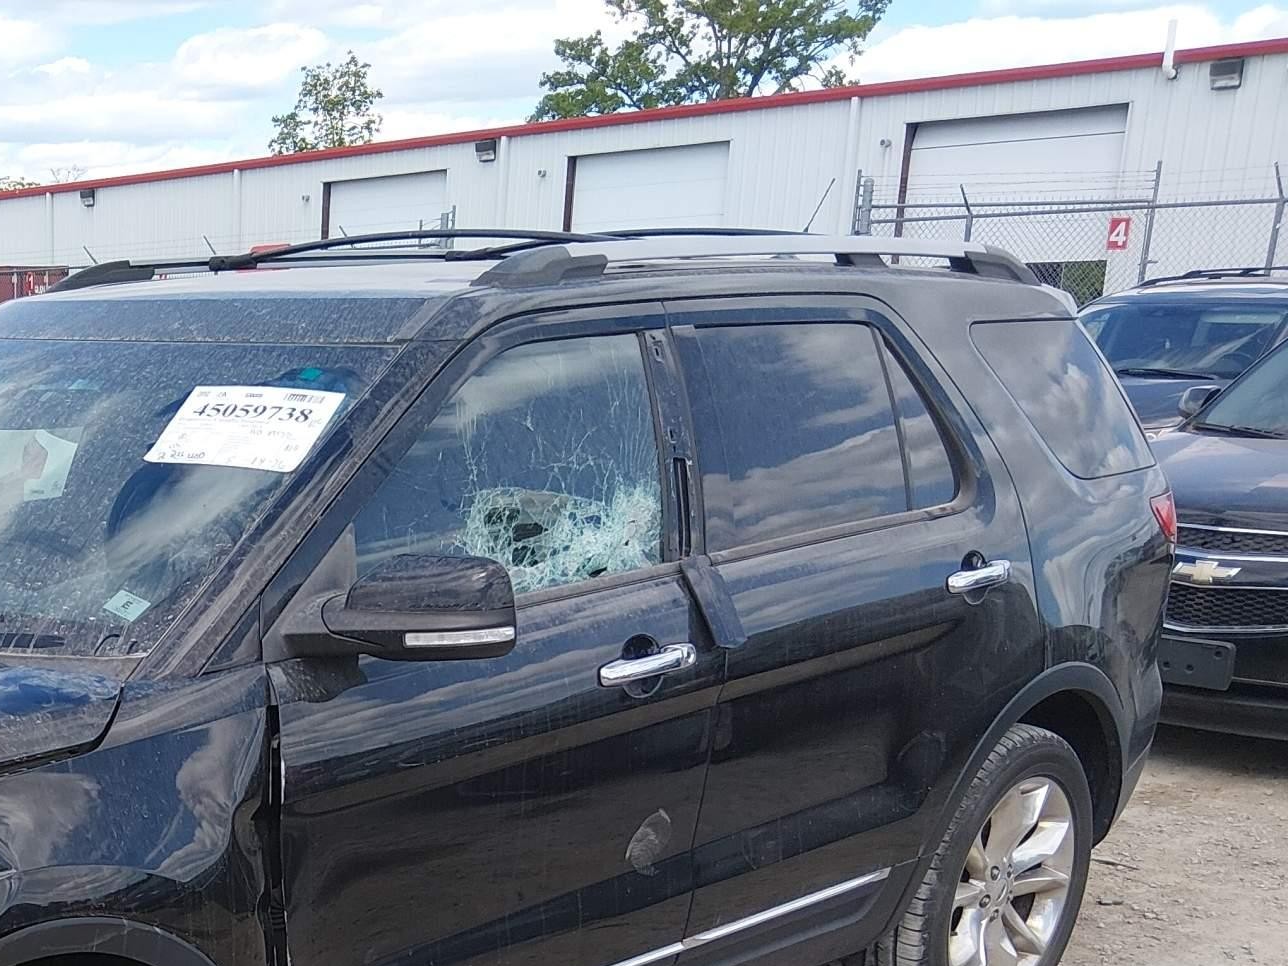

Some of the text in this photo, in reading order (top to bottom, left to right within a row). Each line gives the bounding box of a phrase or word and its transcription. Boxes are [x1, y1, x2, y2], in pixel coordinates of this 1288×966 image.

[1108, 221, 1127, 247] 4
[193, 402, 313, 424] 45059738
[120, 600, 133, 610] E
